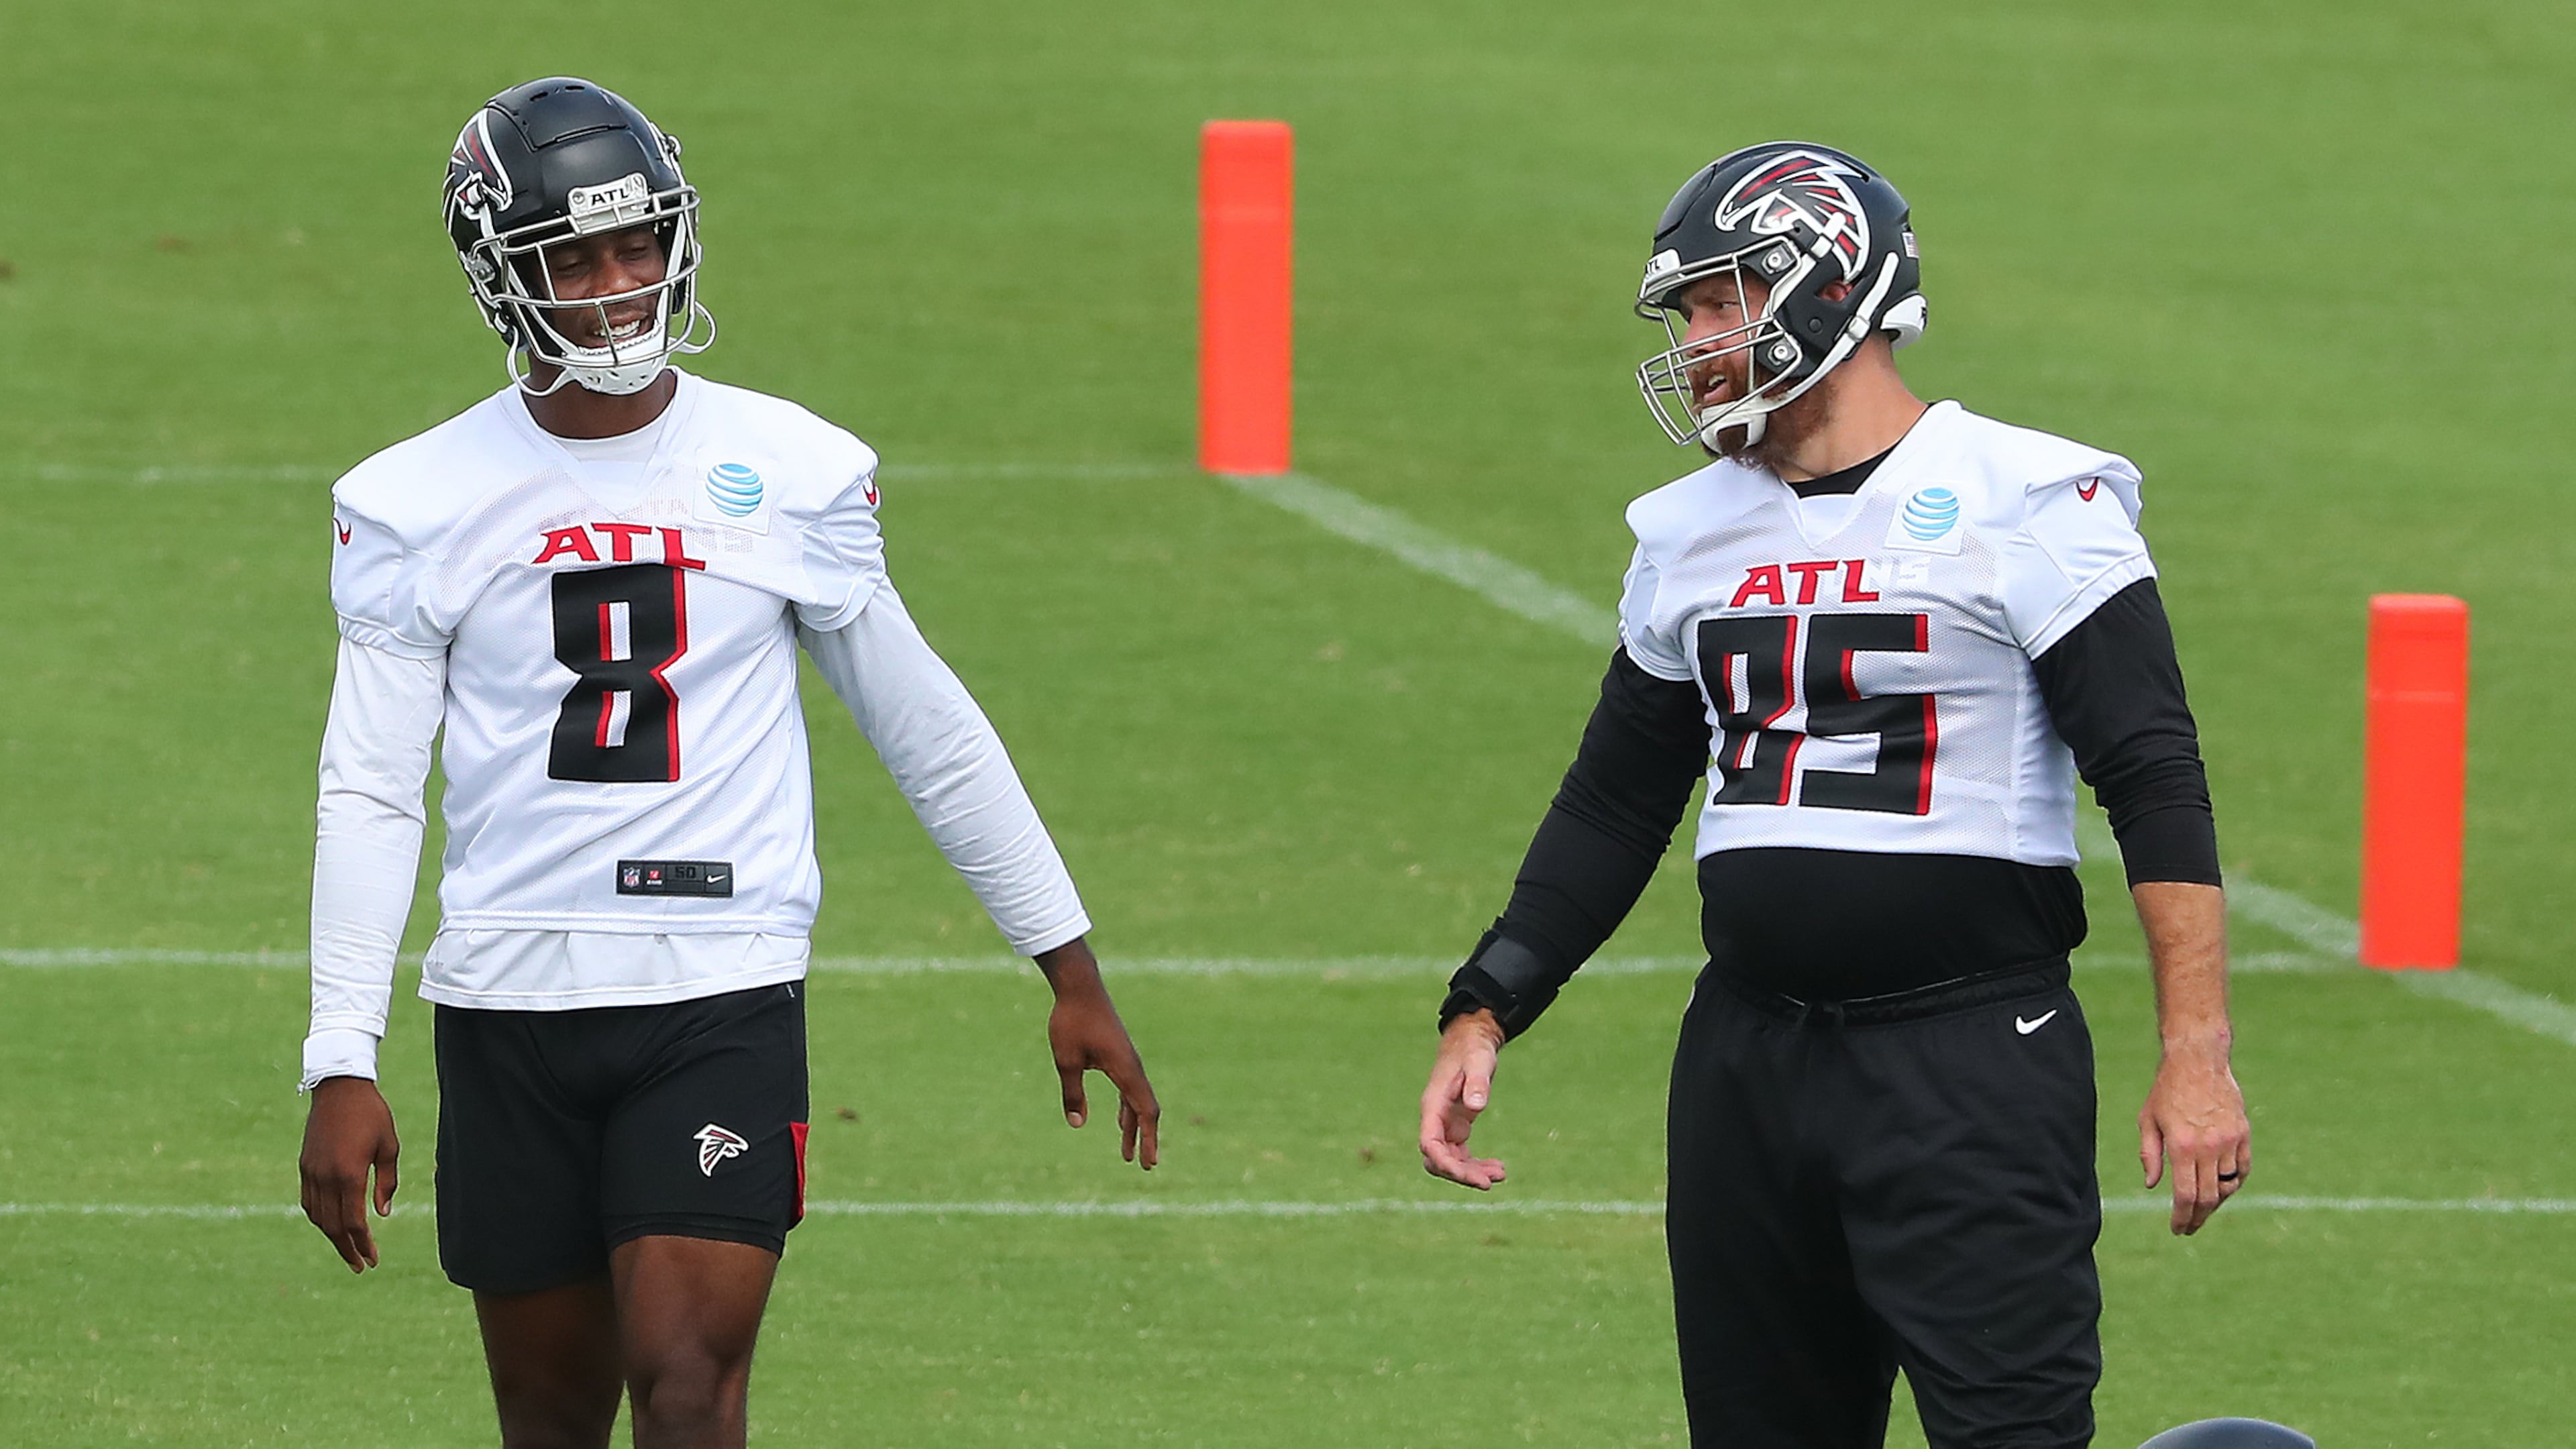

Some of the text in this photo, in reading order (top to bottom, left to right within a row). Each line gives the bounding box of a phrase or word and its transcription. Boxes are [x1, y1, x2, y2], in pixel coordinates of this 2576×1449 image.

[592, 188, 629, 206] ATL
[531, 522, 706, 572] ATL
[1729, 559, 1879, 608] ATL
[547, 564, 688, 783] 8
[1698, 613, 1939, 816] 85
